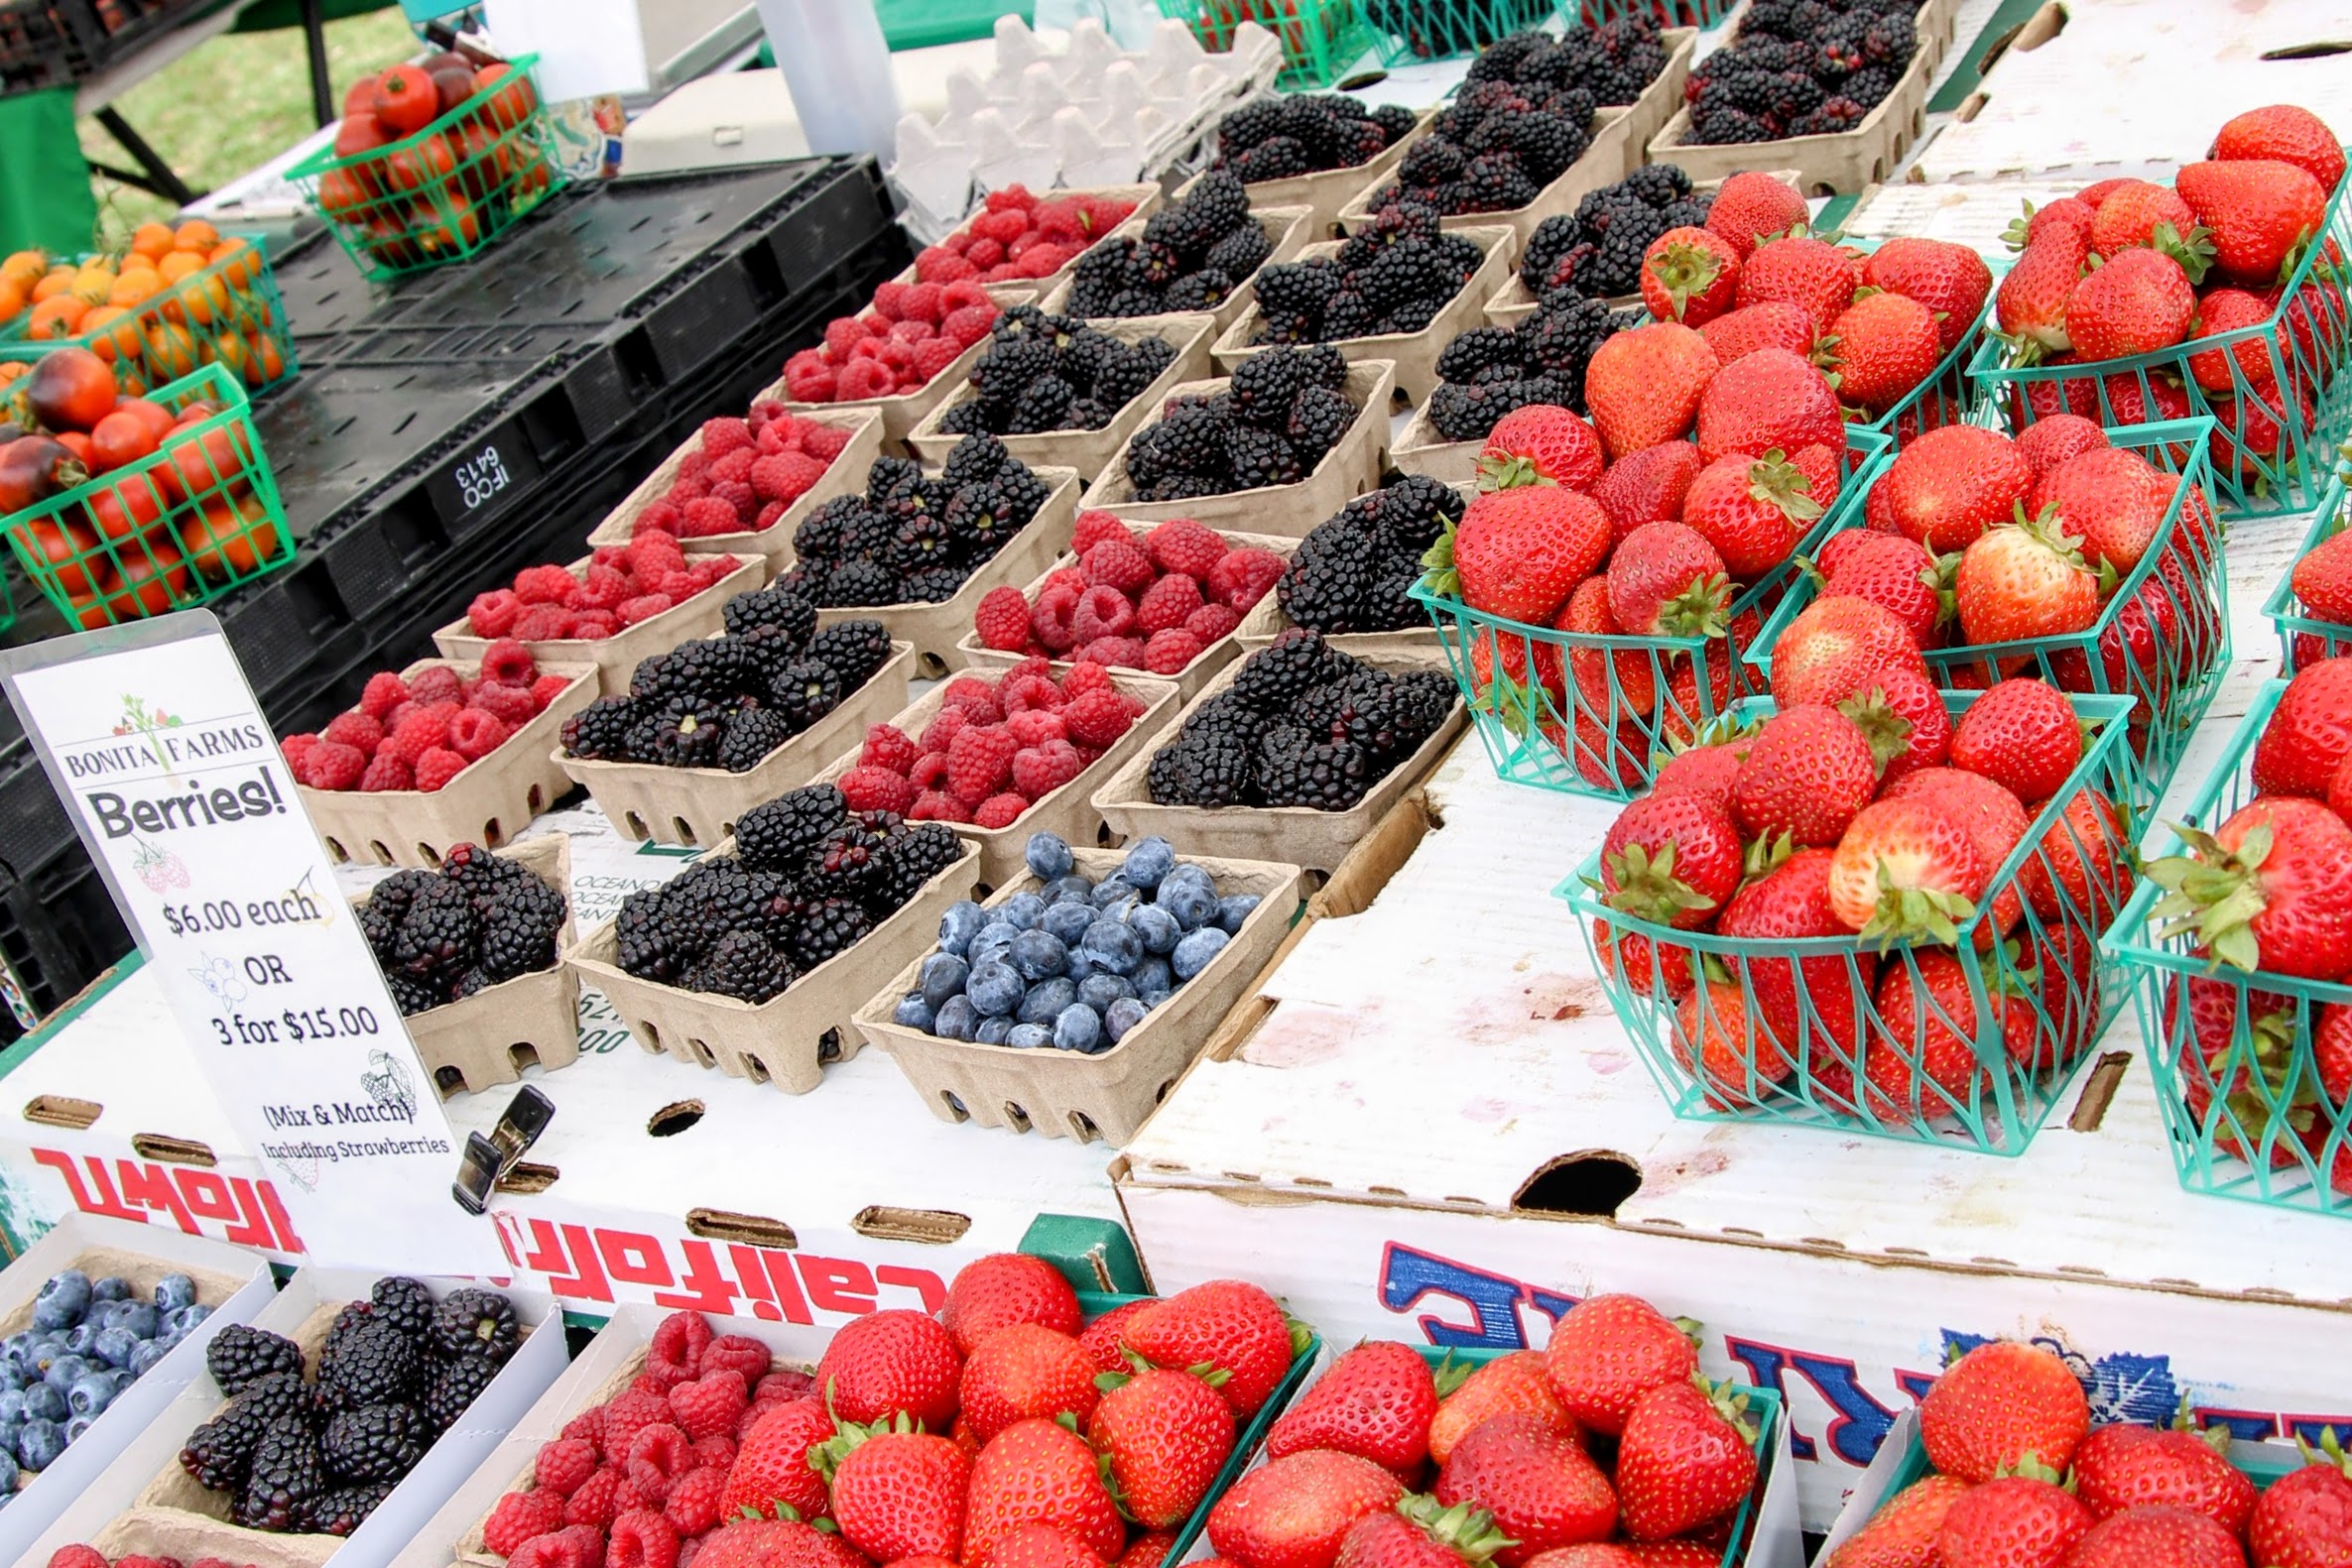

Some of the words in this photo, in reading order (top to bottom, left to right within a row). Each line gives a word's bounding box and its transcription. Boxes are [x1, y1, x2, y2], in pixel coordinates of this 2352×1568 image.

[454, 445, 500, 489] 6413
[463, 463, 511, 509] IFCO
[64, 745, 159, 779] BONITA
[164, 724, 264, 763] FARMS
[86, 765, 287, 839] Berries!
[574, 875, 661, 892] OCEANO
[163, 900, 242, 938] $6.00
[246, 889, 322, 926] each
[243, 954, 294, 986] OR
[211, 1017, 234, 1045] 3
[233, 1014, 280, 1044] for
[282, 1006, 380, 1044] $15.00
[263, 1105, 311, 1132] (Mix
[312, 1103, 333, 1126] &
[331, 1098, 414, 1125] Match)
[261, 1142, 339, 1162] Including
[337, 1135, 450, 1158] Strawberries
